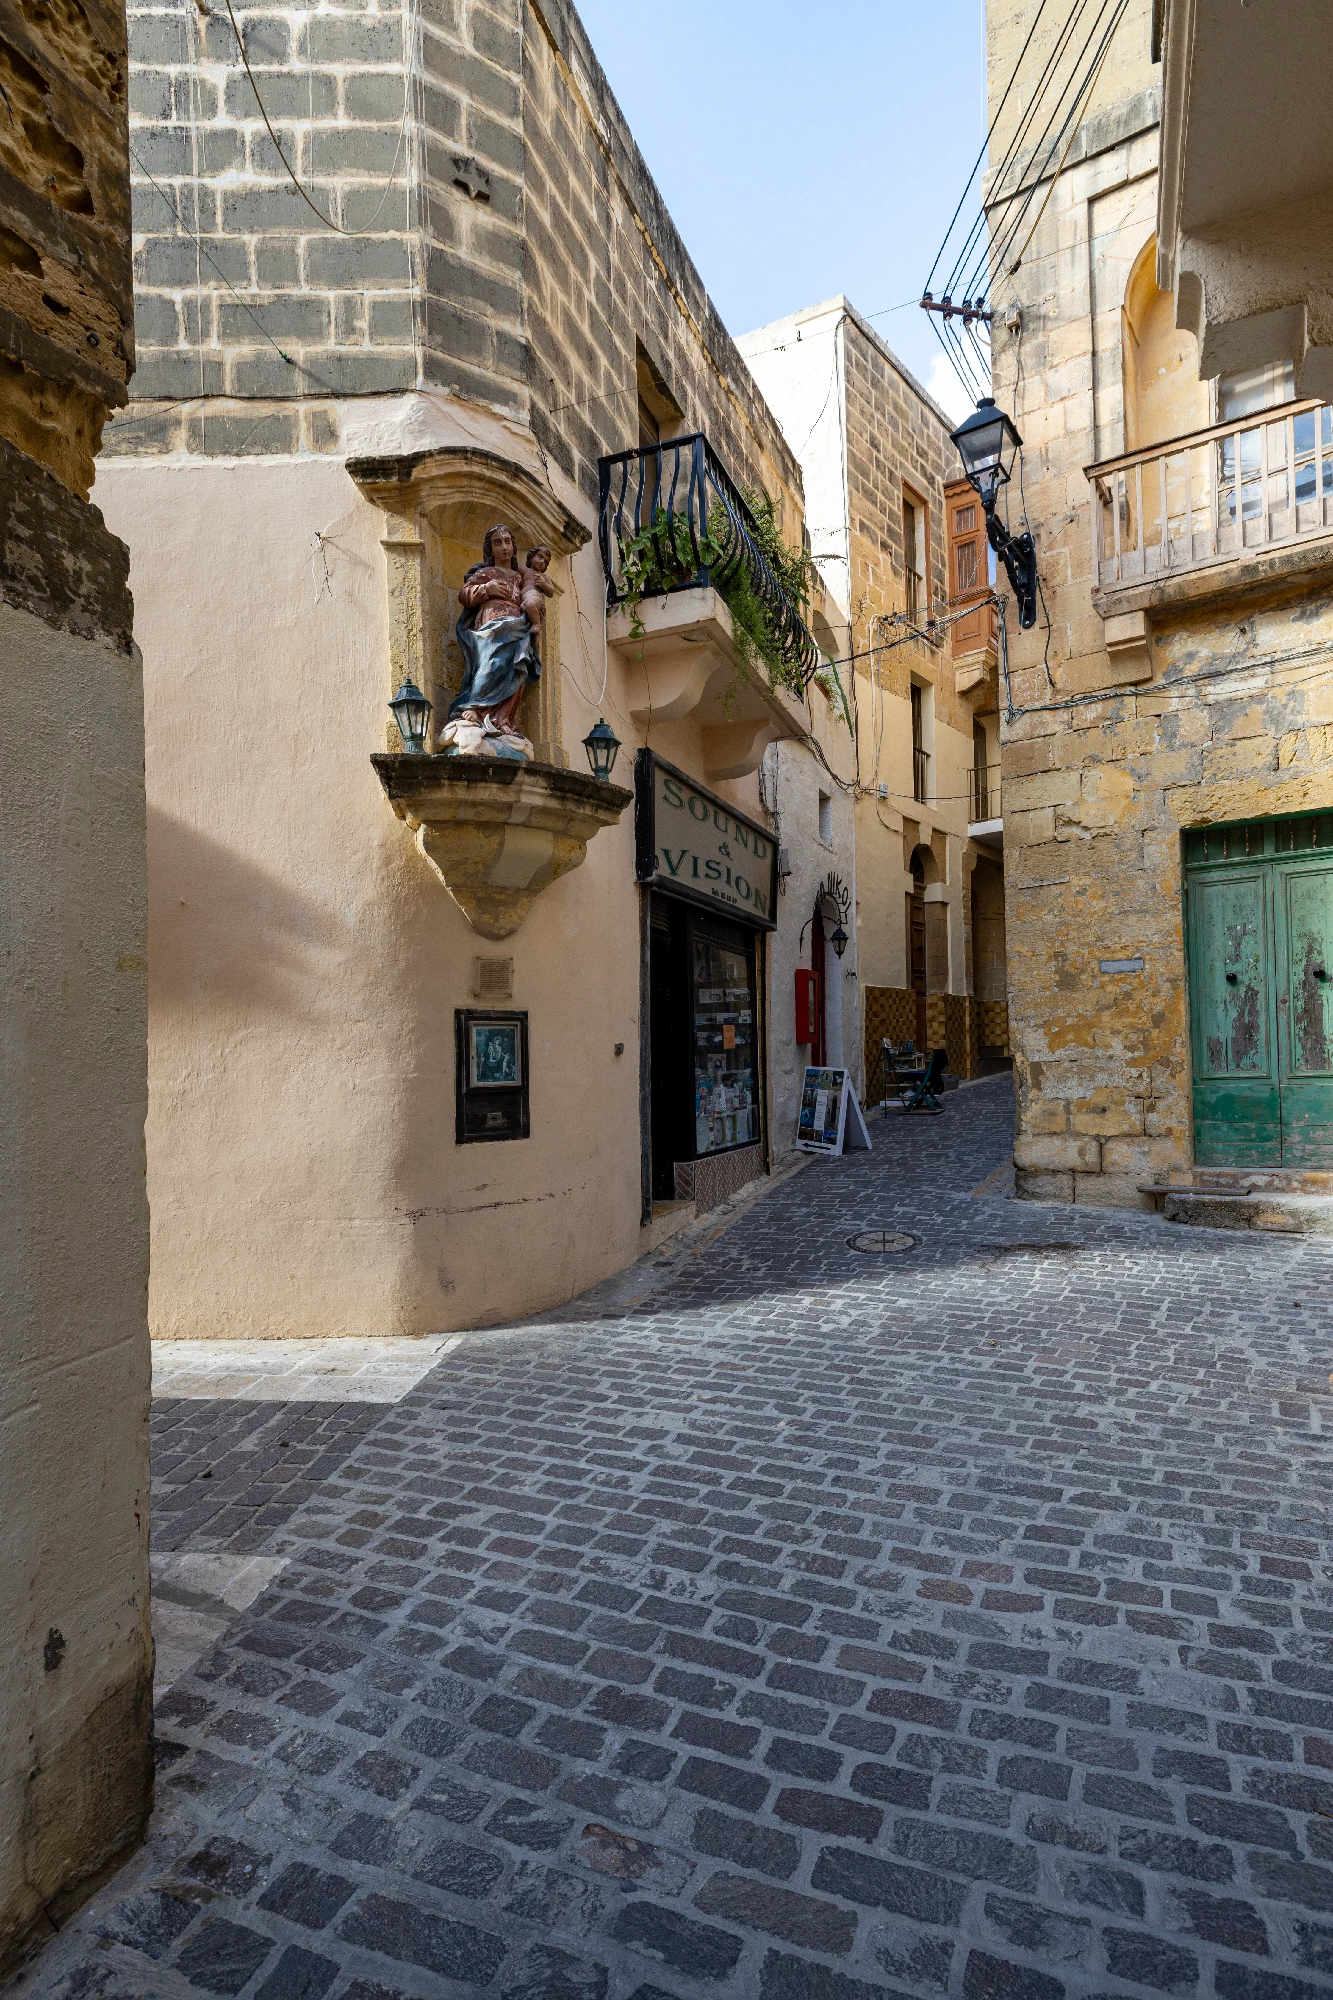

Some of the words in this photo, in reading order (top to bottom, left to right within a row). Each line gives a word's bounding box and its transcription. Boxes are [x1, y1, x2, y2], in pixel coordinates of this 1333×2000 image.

[662, 778, 768, 861] SOUND
[719, 841, 733, 861] &
[660, 848, 769, 916] VISION
